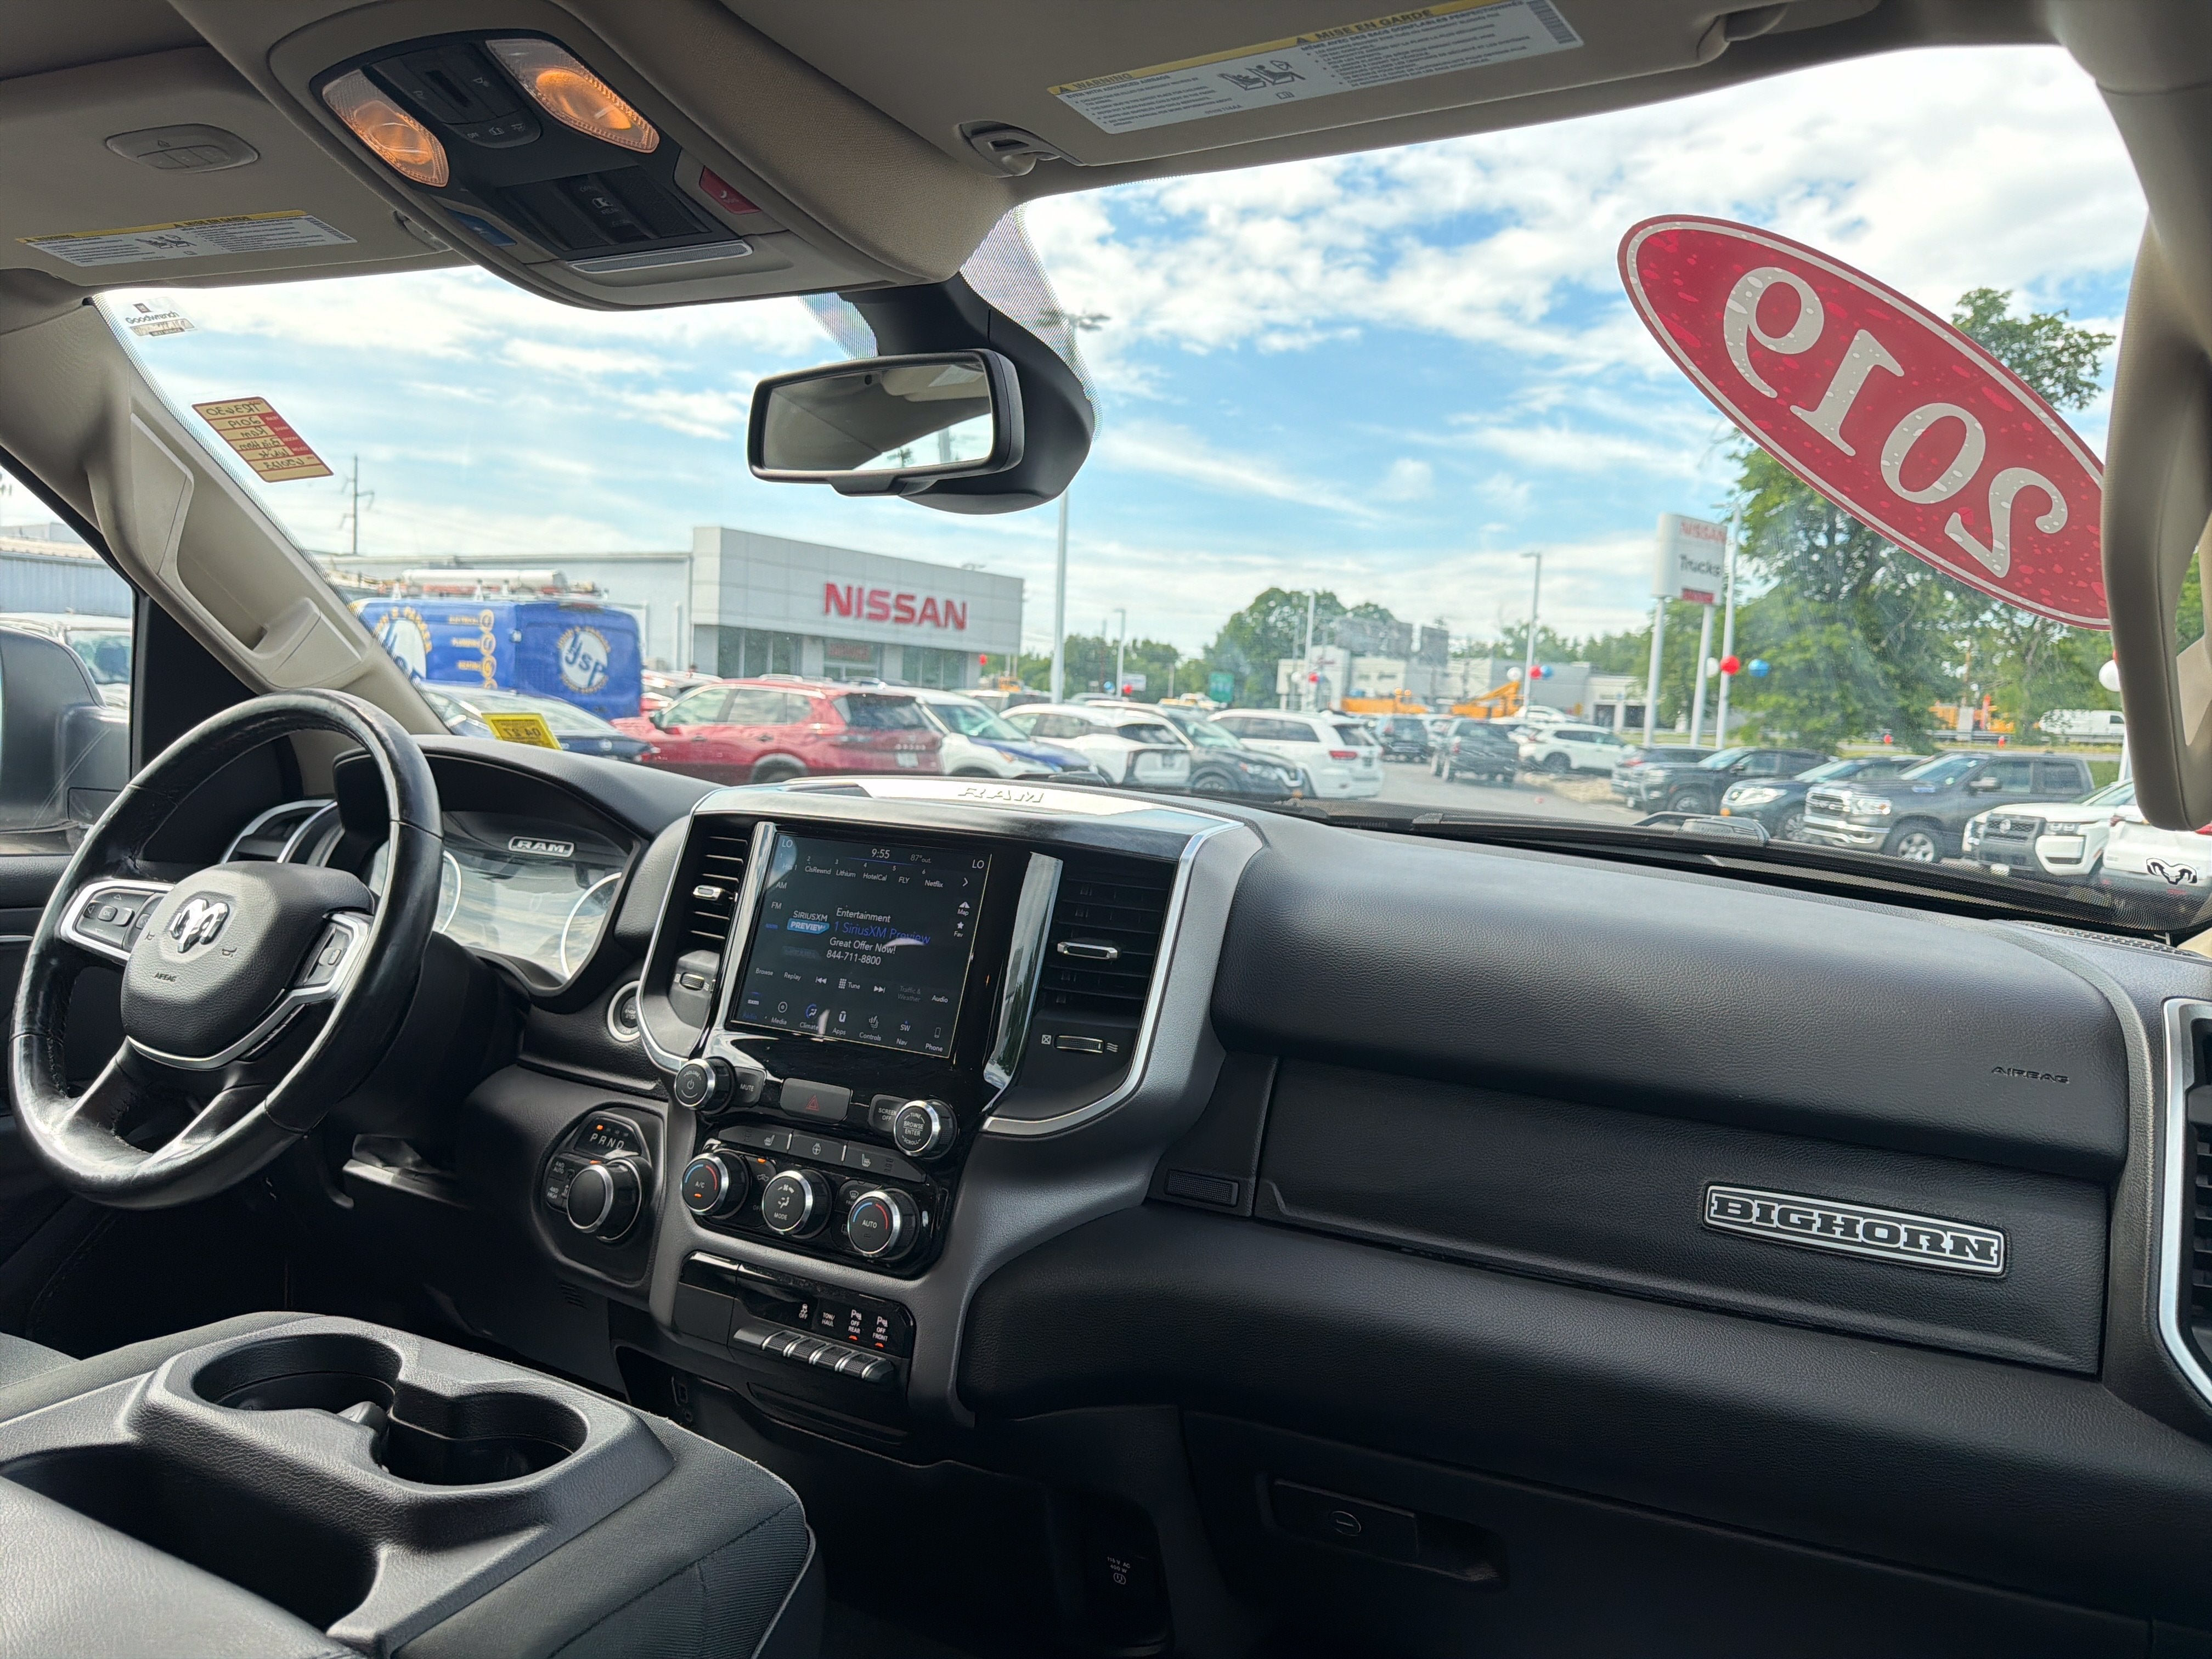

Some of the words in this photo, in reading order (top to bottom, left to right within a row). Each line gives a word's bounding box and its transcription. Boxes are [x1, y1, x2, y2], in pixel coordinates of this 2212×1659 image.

[1316, 25, 1351, 40] MISE
[1358, 20, 1378, 33] EN
[1381, 9, 1430, 27] GARDE
[1073, 72, 1133, 89] WARNING
[125, 311, 180, 324] Goodwrench
[1679, 554, 1721, 578] Trucks
[824, 581, 968, 630] NISSAN
[958, 787, 1044, 803] RAM
[512, 840, 569, 854] RAM
[782, 839, 793, 848] LO
[871, 848, 890, 859] 9:55
[972, 859, 985, 869] LO
[805, 865, 832, 875] ClsRewnd
[836, 869, 856, 878] Lithium
[863, 872, 887, 882] HotelCal
[775, 881, 787, 889] AM
[924, 879, 944, 888] Netflix
[771, 901, 782, 910] FM
[793, 910, 828, 922] SIRIUSXM
[836, 907, 891, 923] Entertainment
[957, 909, 969, 917] Map
[791, 921, 826, 931] PREVIEW
[842, 922, 887, 938] SiriusXM
[889, 928, 931, 944] Preview
[830, 936, 851, 948] Great
[853, 940, 873, 951] Offer
[875, 943, 896, 955] Now!
[826, 949, 881, 966] 844-711-8800
[755, 968, 774, 976] Browse
[783, 972, 801, 981] Replay
[154, 972, 177, 983] AIRBAG
[848, 981, 861, 990] Tune
[898, 994, 921, 1002] Weather
[932, 995, 949, 1003] Audio
[771, 1017, 787, 1025] Media
[799, 1022, 819, 1031] Climate
[832, 1028, 847, 1036] Apps
[859, 1032, 882, 1041] Controls
[896, 1038, 908, 1046] Nav
[925, 1043, 943, 1052] Phone
[1991, 1066, 2069, 1084] AIRBAG
[740, 1084, 754, 1092] MUTE
[878, 1108, 898, 1116] SCREEN
[904, 1121, 924, 1130] BROWSE
[905, 1128, 921, 1137] ENTER
[553, 1166, 564, 1174] AUTO
[774, 1212, 788, 1221] MODE
[862, 1220, 877, 1228] AUTO
[1709, 1193, 1998, 1267] BIGHORN
[823, 1312, 835, 1321] TOW/
[822, 1319, 834, 1327] HAUL
[848, 1326, 861, 1334] REAR
[872, 1332, 888, 1342] FRONT
